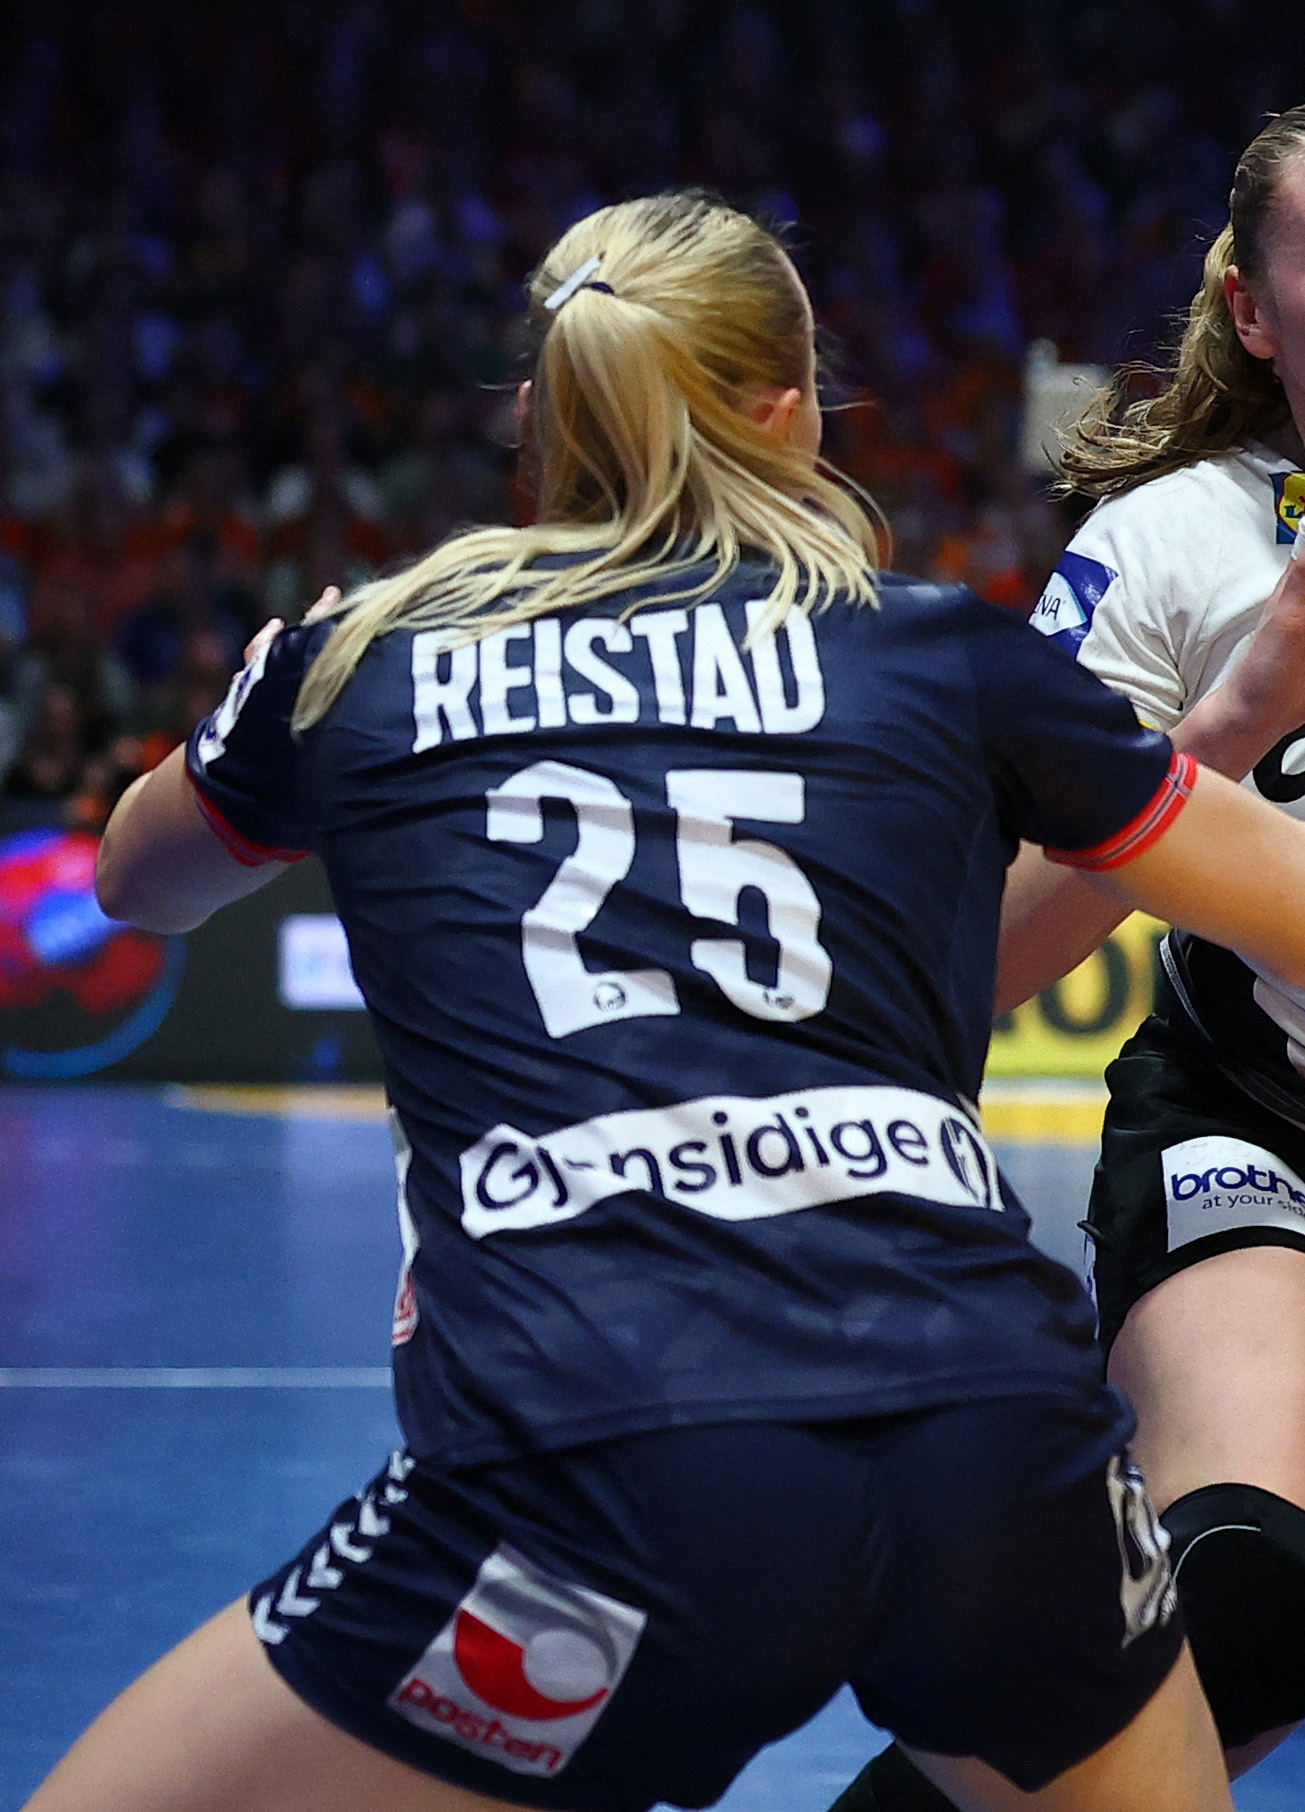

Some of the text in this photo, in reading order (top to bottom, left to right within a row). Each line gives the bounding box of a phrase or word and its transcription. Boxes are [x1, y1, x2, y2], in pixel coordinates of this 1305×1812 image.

[411, 599, 826, 754] REISTAD
[485, 760, 834, 1039] 25
[475, 1105, 928, 1212] Gjnsidige
[1202, 1194, 1222, 1210] at
[1228, 1194, 1273, 1209] your
[399, 1677, 563, 1770] posten
